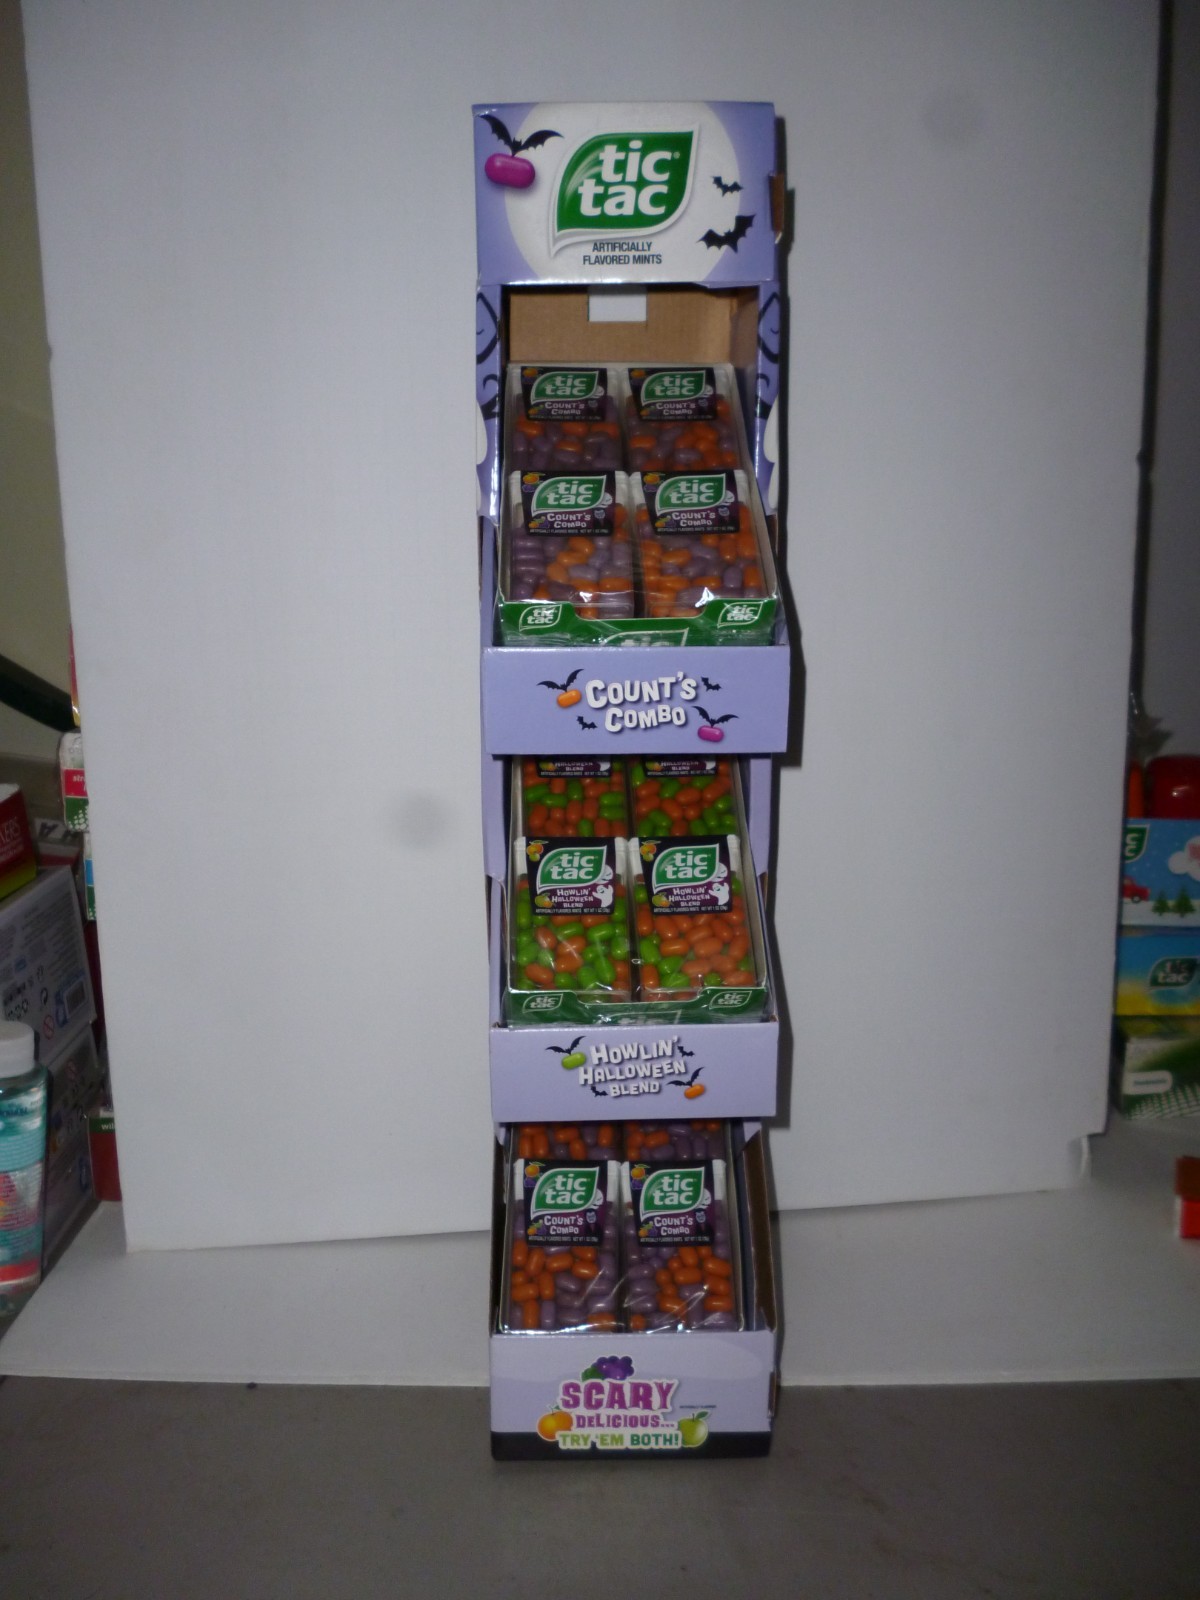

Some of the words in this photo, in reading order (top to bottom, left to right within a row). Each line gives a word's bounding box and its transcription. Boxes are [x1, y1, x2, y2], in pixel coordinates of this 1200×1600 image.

[599, 140, 673, 183] tic
[578, 178, 668, 217] tac
[592, 242, 652, 253] ARTIFICIALLY
[582, 254, 630, 265] FLAVORED
[632, 254, 662, 265] MINTS
[555, 375, 587, 387] tic
[663, 375, 695, 387] tic
[544, 384, 586, 396] tac
[654, 385, 695, 396] tac
[557, 481, 593, 494] tic
[678, 480, 714, 493] tic
[546, 493, 591, 505] tac
[669, 492, 714, 504] tac
[527, 615, 553, 624] tac
[726, 612, 753, 621] tac
[585, 671, 697, 709] COUNT'S
[604, 704, 686, 732] COMBO
[560, 852, 594, 868] tic
[672, 851, 707, 867] tic
[550, 865, 593, 880] tac
[664, 864, 706, 879] tac
[590, 1035, 680, 1065] HOWLIN'
[578, 1059, 686, 1085] HALLOWEEN
[609, 1081, 660, 1098] BLEND
[554, 1174, 588, 1191] tic
[661, 1174, 695, 1192] tic
[544, 1188, 587, 1205] tac
[653, 1189, 694, 1206] tac
[550, 1226, 579, 1235] COMBO
[661, 1226, 690, 1236] COMBO
[560, 1381, 677, 1411] SCARY
[558, 1433, 591, 1446] TRY
[595, 1433, 624, 1446] 'EM
[630, 1433, 679, 1446] BOTH!
